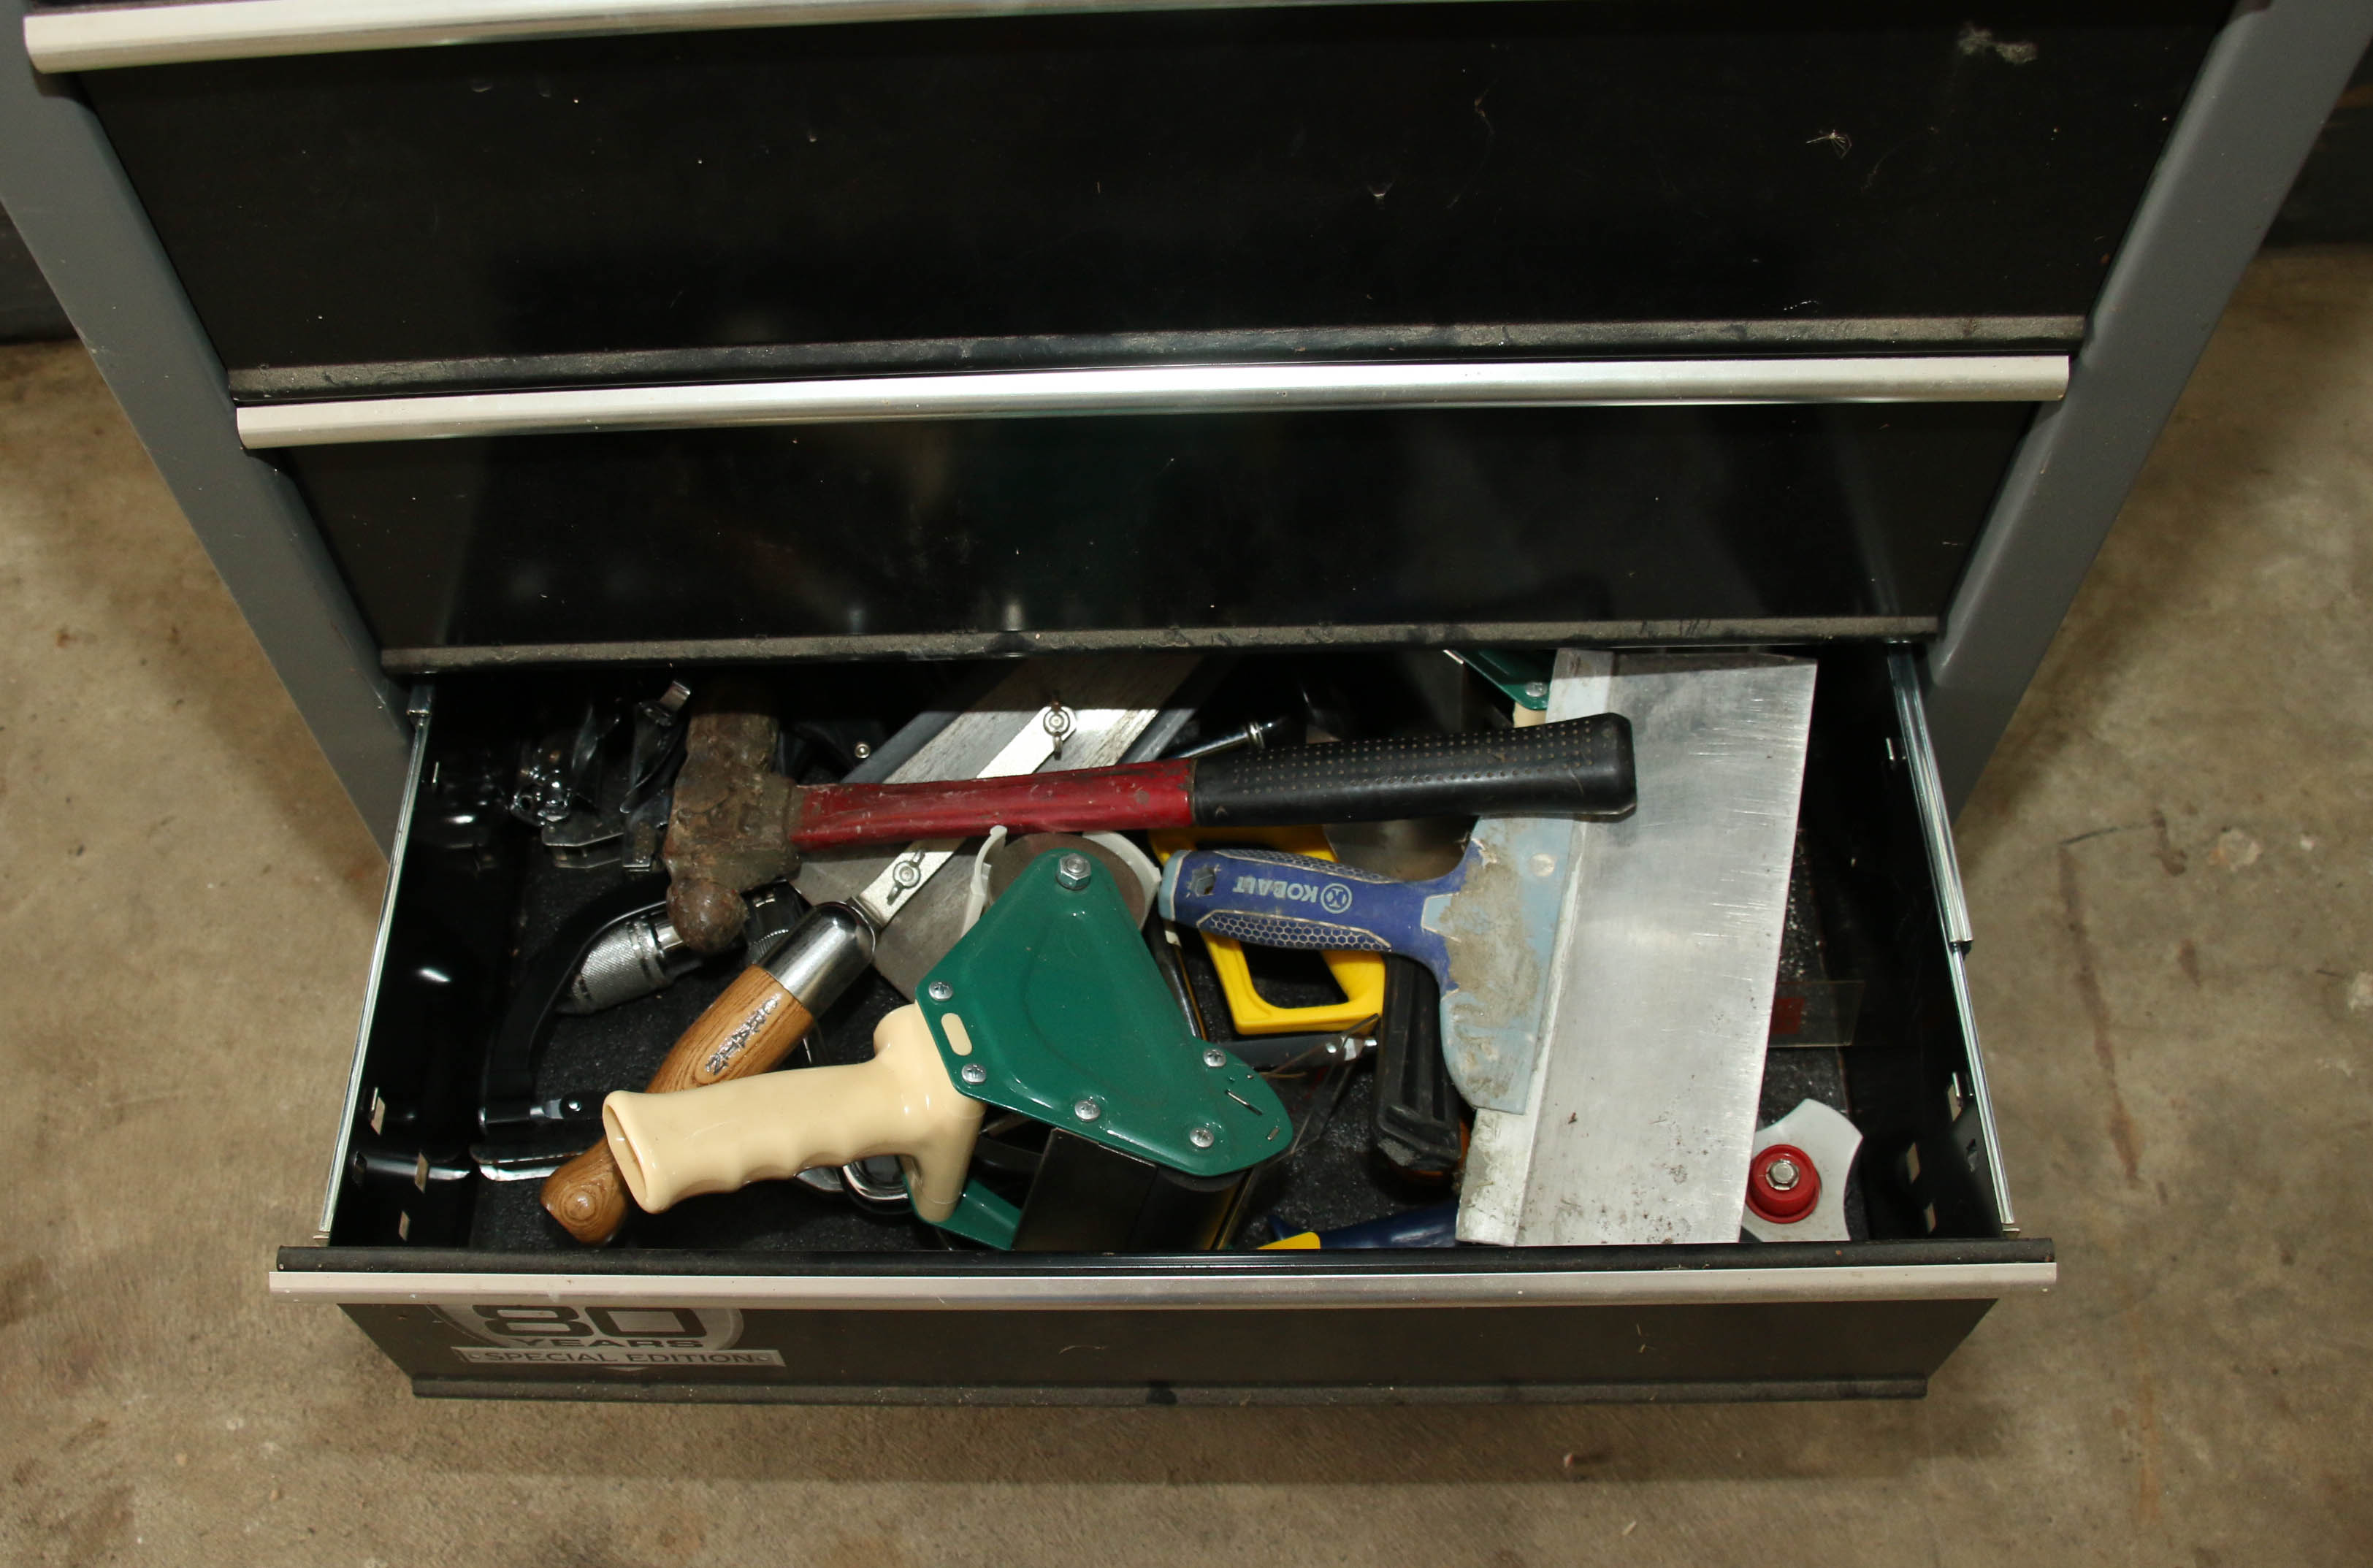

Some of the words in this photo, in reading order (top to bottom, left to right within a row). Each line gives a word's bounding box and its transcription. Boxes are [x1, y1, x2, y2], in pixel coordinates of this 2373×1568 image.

[1232, 876, 1318, 903] KOBALT
[705, 994, 779, 1075] CRAIN
[473, 1304, 707, 1338] 80
[510, 1339, 703, 1348] YEARS
[484, 1352, 617, 1364] SPECIAL
[626, 1353, 758, 1364] EDITION
